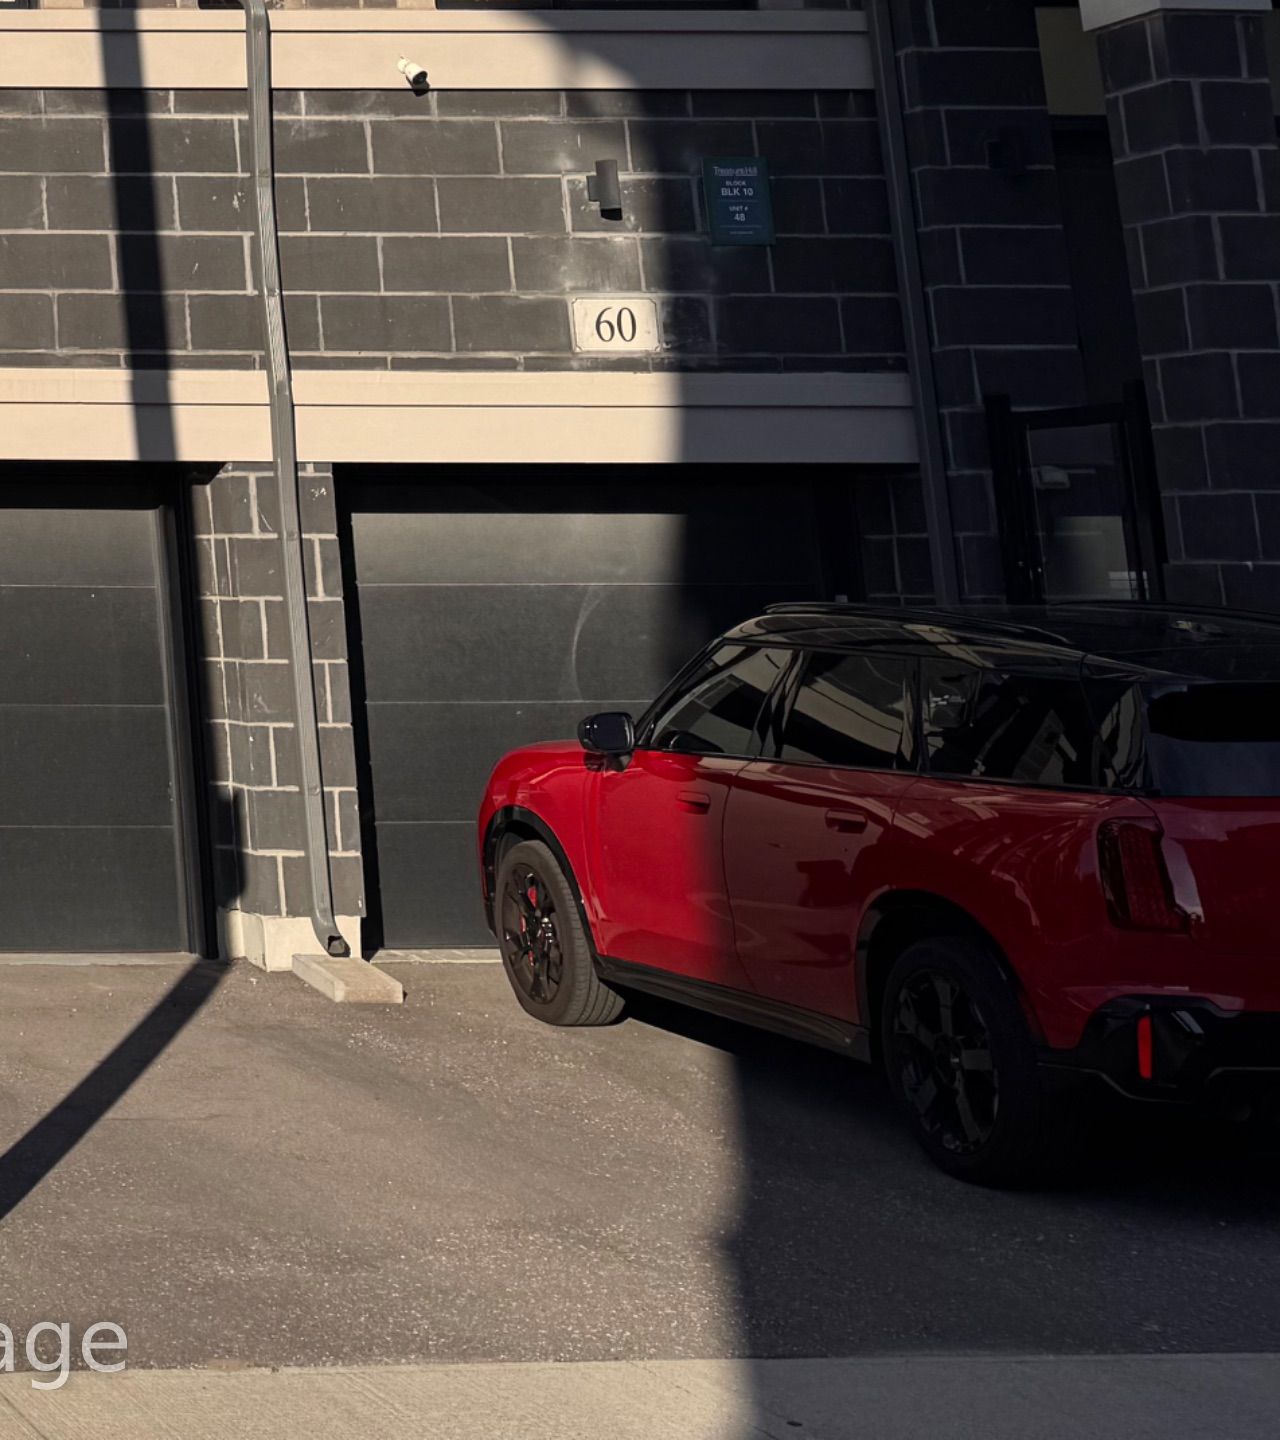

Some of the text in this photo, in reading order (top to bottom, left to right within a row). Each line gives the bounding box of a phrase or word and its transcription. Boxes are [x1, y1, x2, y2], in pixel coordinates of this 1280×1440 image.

[721, 187, 754, 196] BLK 10
[595, 307, 637, 342] 60
